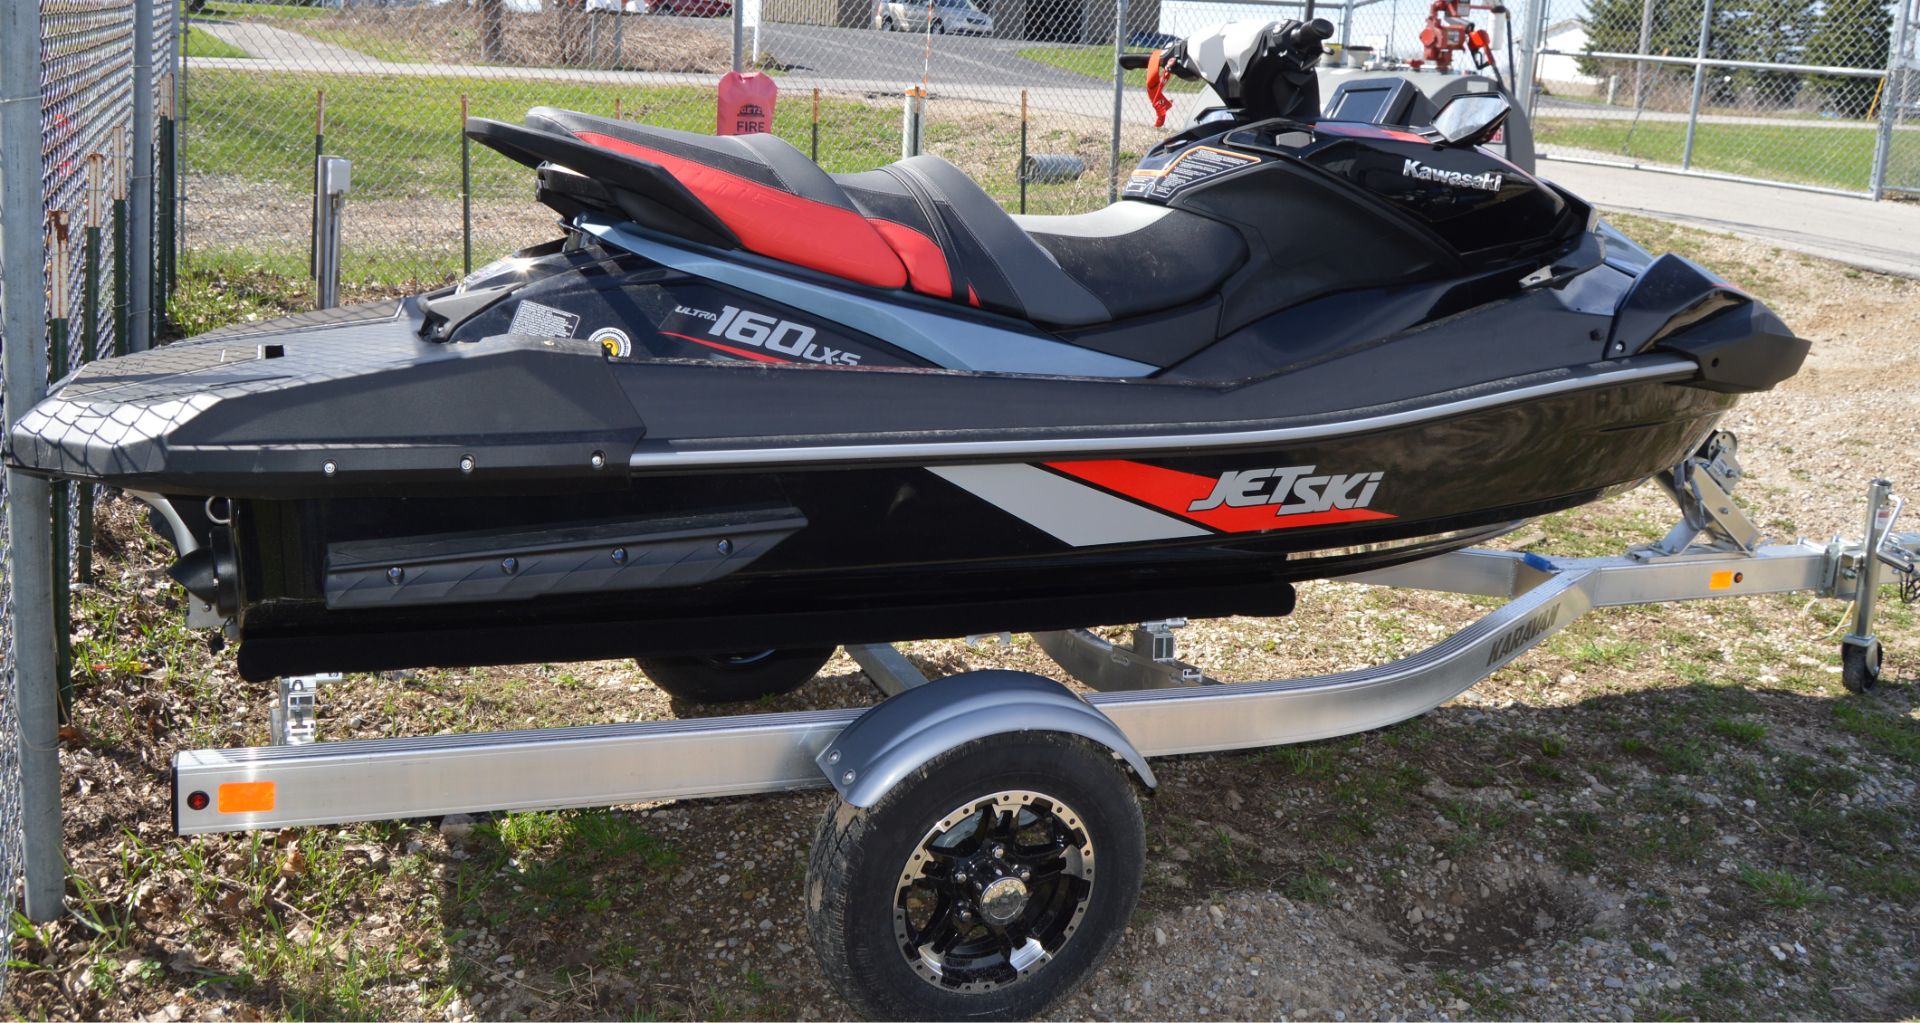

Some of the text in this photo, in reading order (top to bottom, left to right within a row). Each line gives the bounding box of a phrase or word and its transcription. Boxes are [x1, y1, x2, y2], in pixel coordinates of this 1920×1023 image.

[736, 121, 765, 133] FIRE
[1402, 158, 1502, 192] Kawasaki
[674, 305, 717, 321] ULTRA
[708, 305, 817, 357] 160
[1486, 602, 1561, 667] KARAVAN
